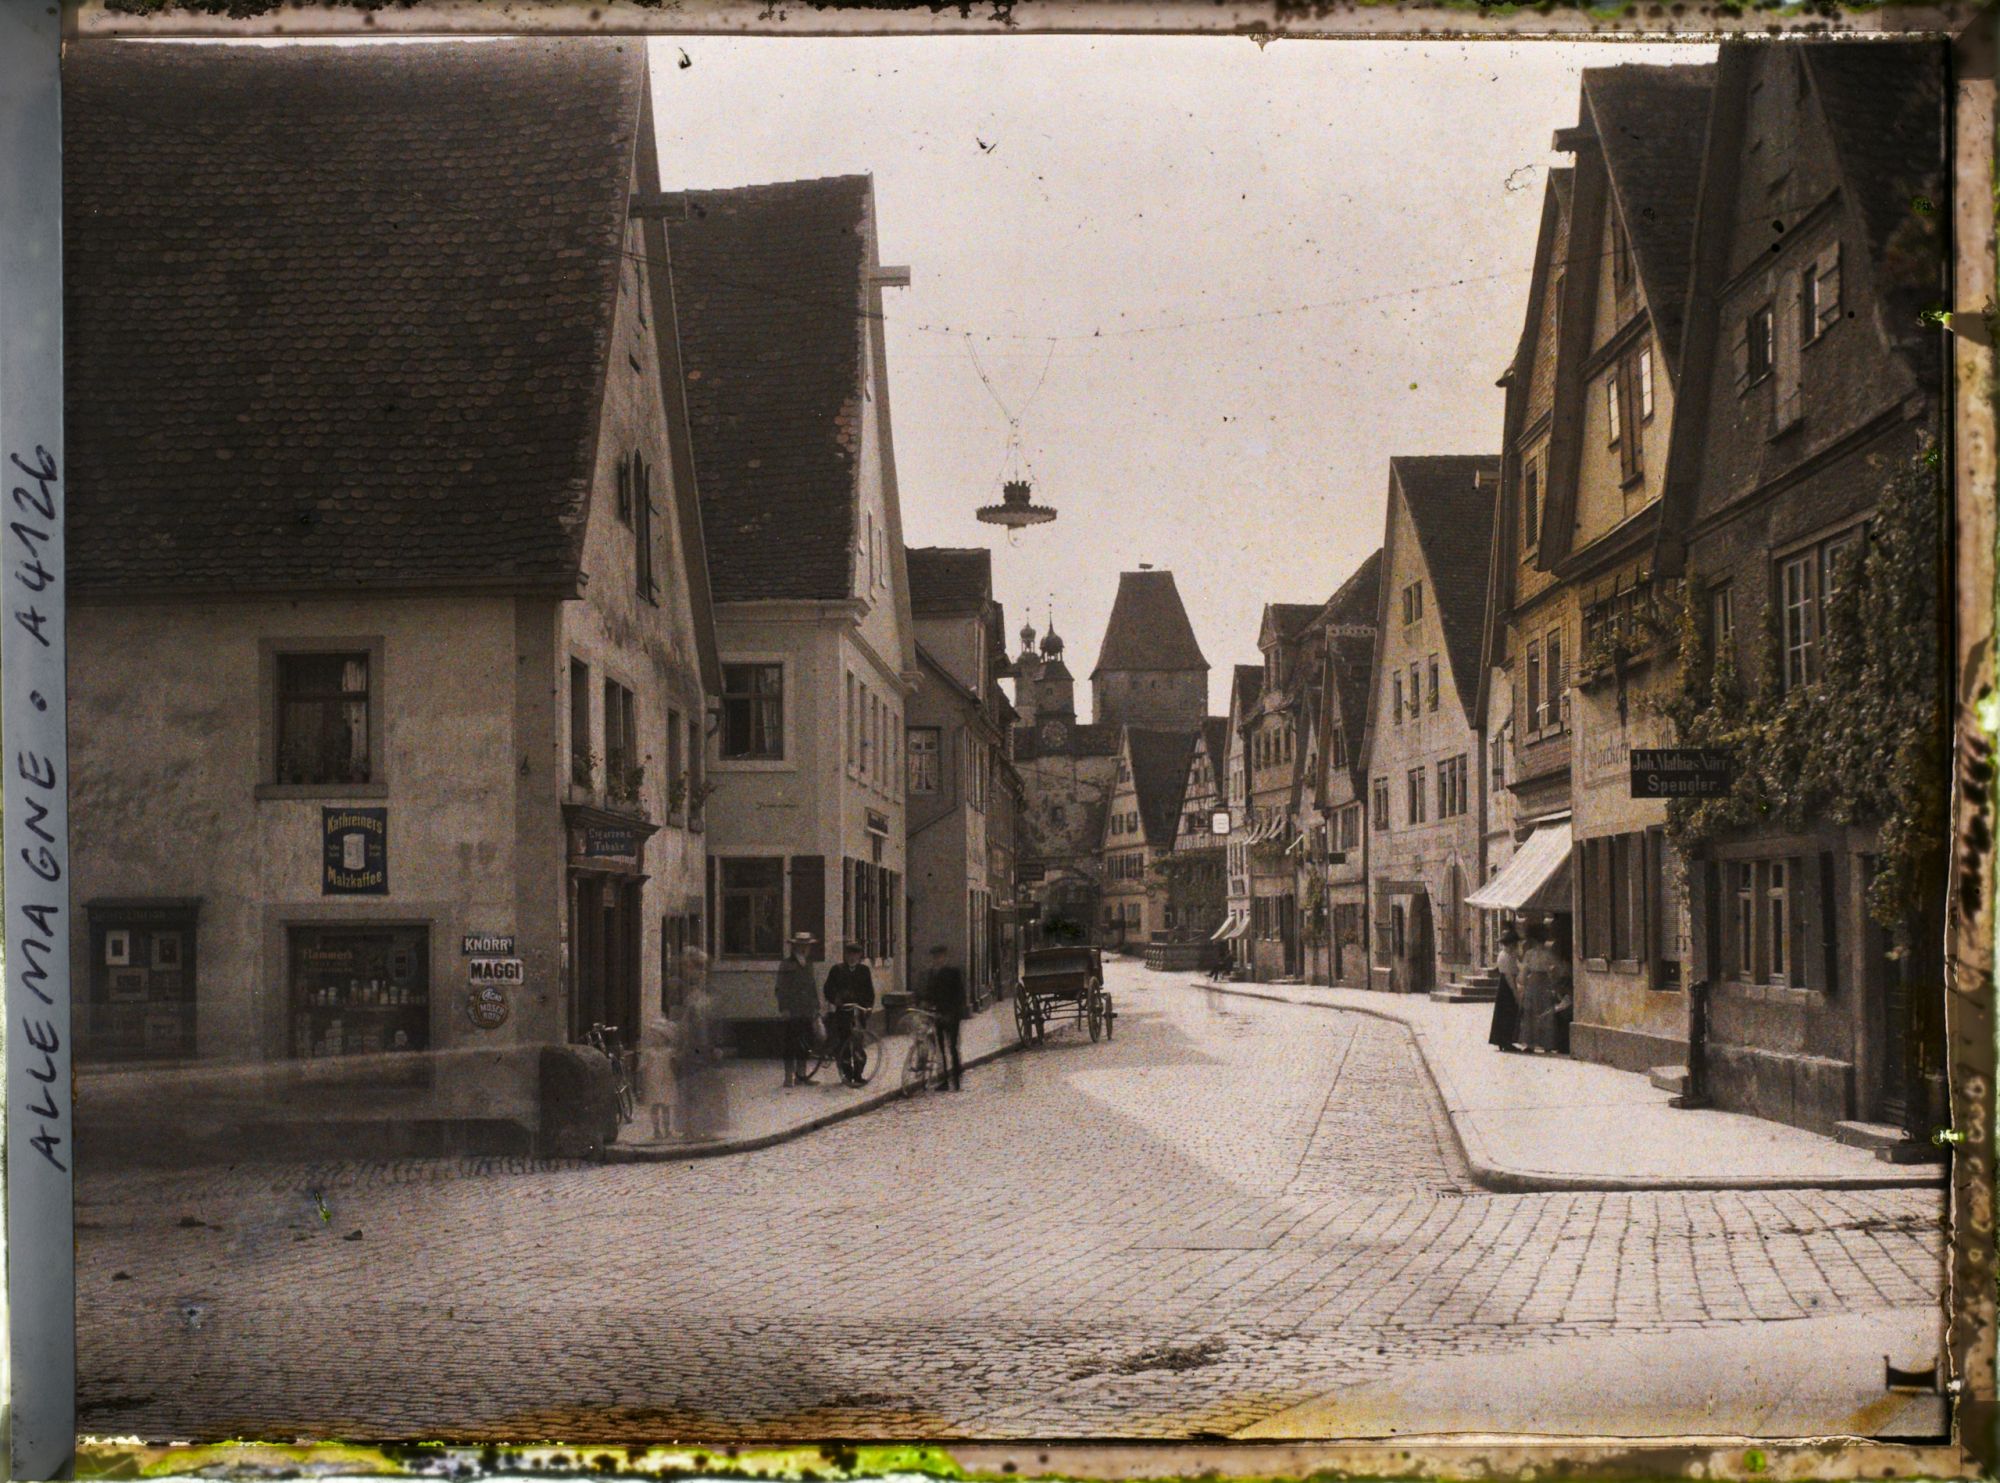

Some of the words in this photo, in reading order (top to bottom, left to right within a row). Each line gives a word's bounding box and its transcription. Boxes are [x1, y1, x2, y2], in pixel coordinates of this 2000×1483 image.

[1633, 753, 1657, 771] Joh.
[1656, 752, 1700, 771] Mathias
[327, 865, 383, 888] Malzkaffee
[18, 750, 66, 1173] ALLEMAGNE
[471, 962, 520, 979] MAGGI
